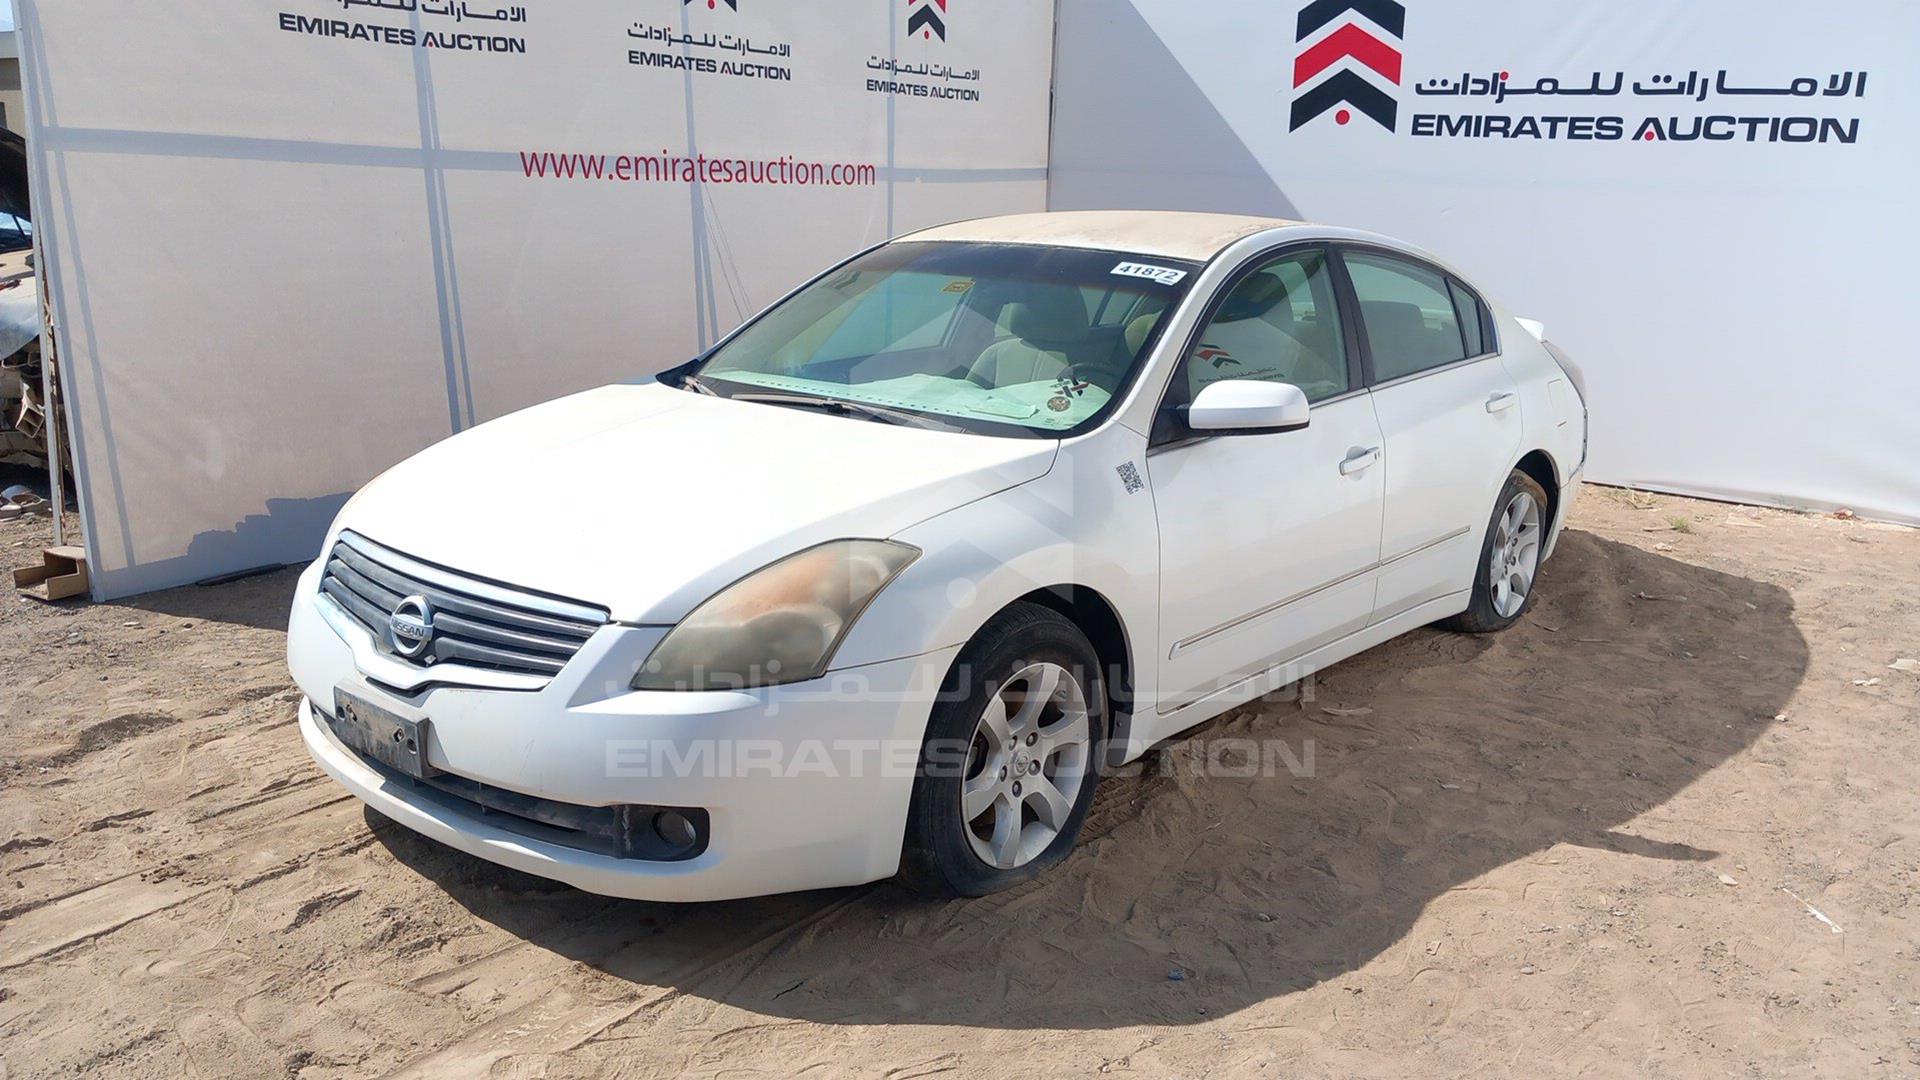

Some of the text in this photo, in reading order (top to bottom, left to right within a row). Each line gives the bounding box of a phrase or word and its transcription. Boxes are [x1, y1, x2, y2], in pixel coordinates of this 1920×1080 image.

[279, 13, 526, 53] EMIRATES AUCTION
[627, 22, 790, 57] الامارات للمزادات
[628, 50, 791, 81] EMIRATES AUCTION
[866, 79, 980, 102] EMIRATES AUCTION
[1415, 70, 1868, 104] الامارات للمزادات
[1411, 114, 1860, 143] EMIRATES AUCTION
[519, 149, 876, 186] www.emiratesauction.com
[1118, 265, 1179, 280] 41872
